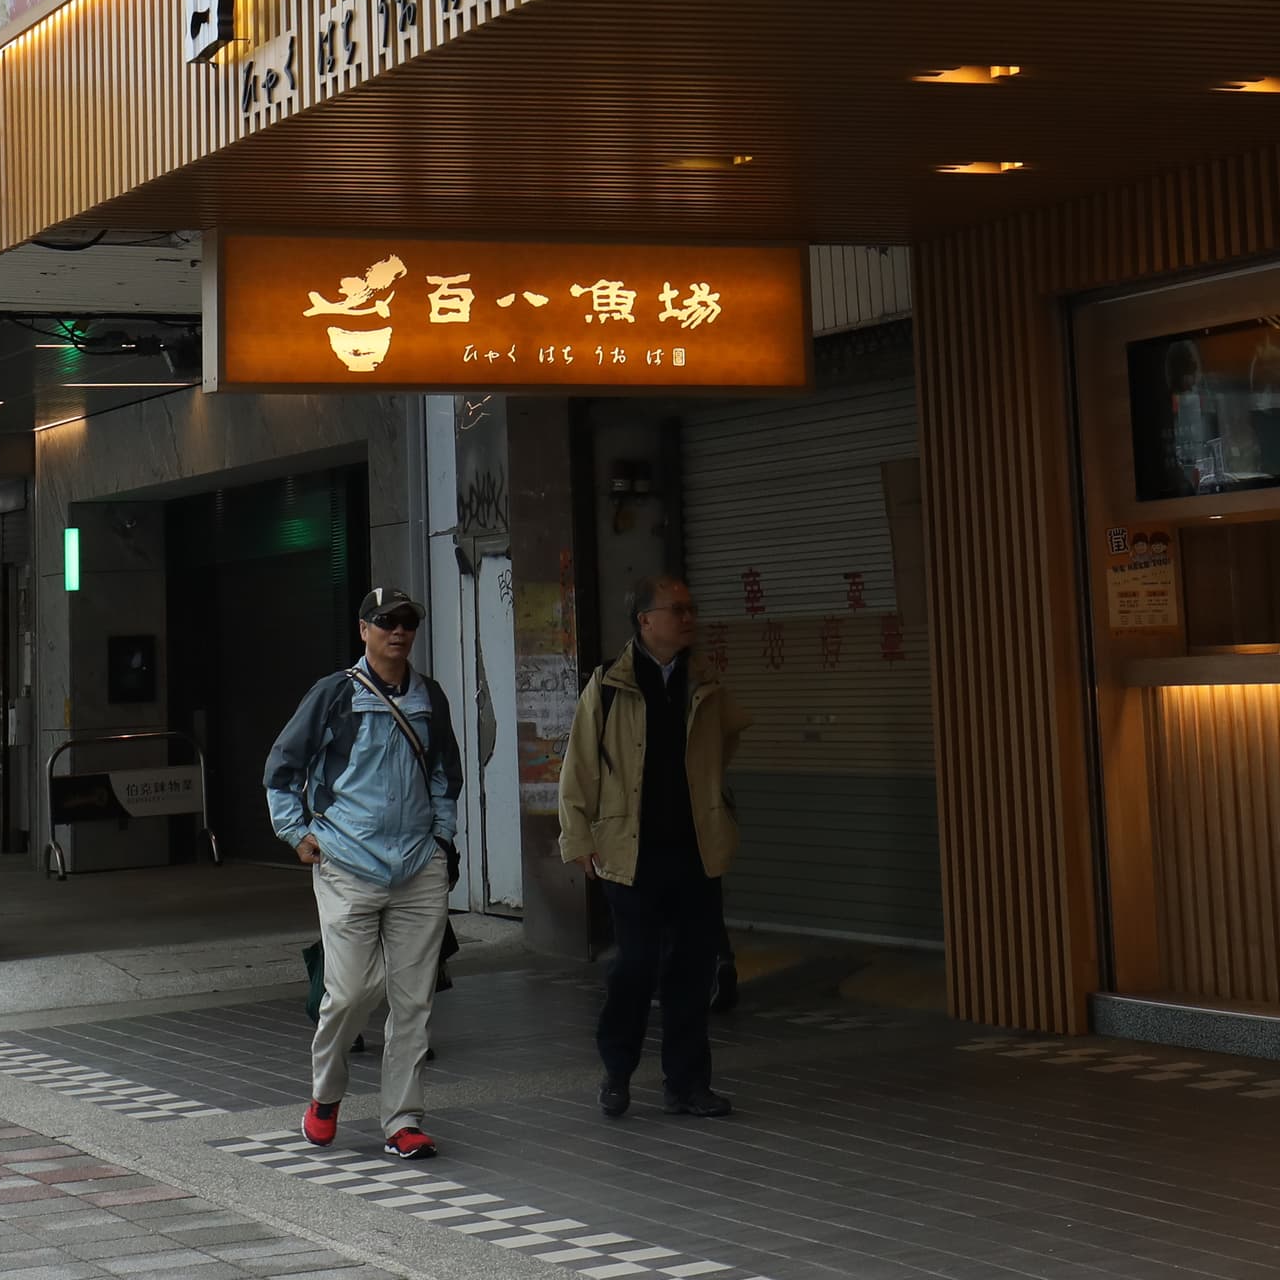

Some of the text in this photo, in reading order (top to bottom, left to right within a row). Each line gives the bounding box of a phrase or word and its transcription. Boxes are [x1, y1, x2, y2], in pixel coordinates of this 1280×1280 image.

[425, 272, 722, 329] 百八魚場
[463, 343, 519, 364] ひゃく
[538, 344, 575, 365] はち
[593, 346, 628, 365] うお
